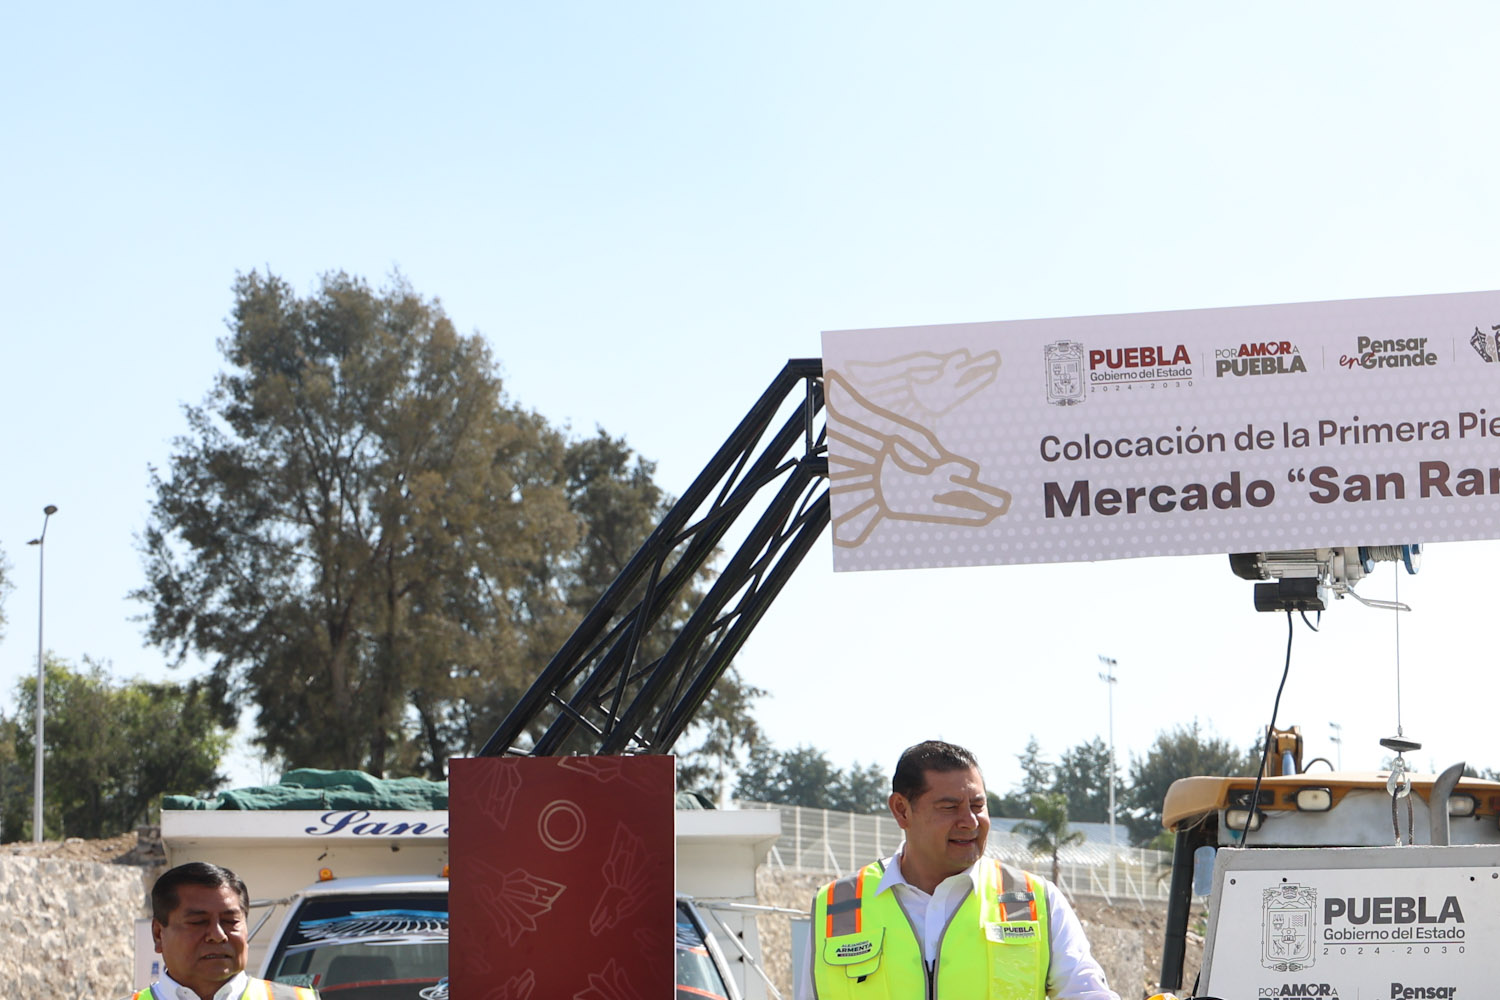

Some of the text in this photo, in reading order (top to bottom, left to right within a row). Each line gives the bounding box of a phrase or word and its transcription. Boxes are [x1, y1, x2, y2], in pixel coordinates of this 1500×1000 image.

[1357, 335, 1428, 354] Pensar
[1089, 344, 1191, 370] PUEBLA
[1216, 355, 1307, 378] PUEBLA
[1360, 349, 1437, 370] Grande
[1090, 366, 1192, 382] Gobierno del Estado
[1040, 425, 1226, 462] Colocación
[1234, 424, 1275, 451] de
[1283, 421, 1310, 448] la
[1318, 415, 1450, 446] Primera
[1043, 471, 1275, 518] Mercado
[305, 810, 446, 836] San
[1323, 896, 1465, 925] PUEBLA
[1323, 926, 1466, 941] Gobierno del Estado
[836, 942, 872, 953] ARMENTA
[1390, 982, 1457, 1000] Pensar
